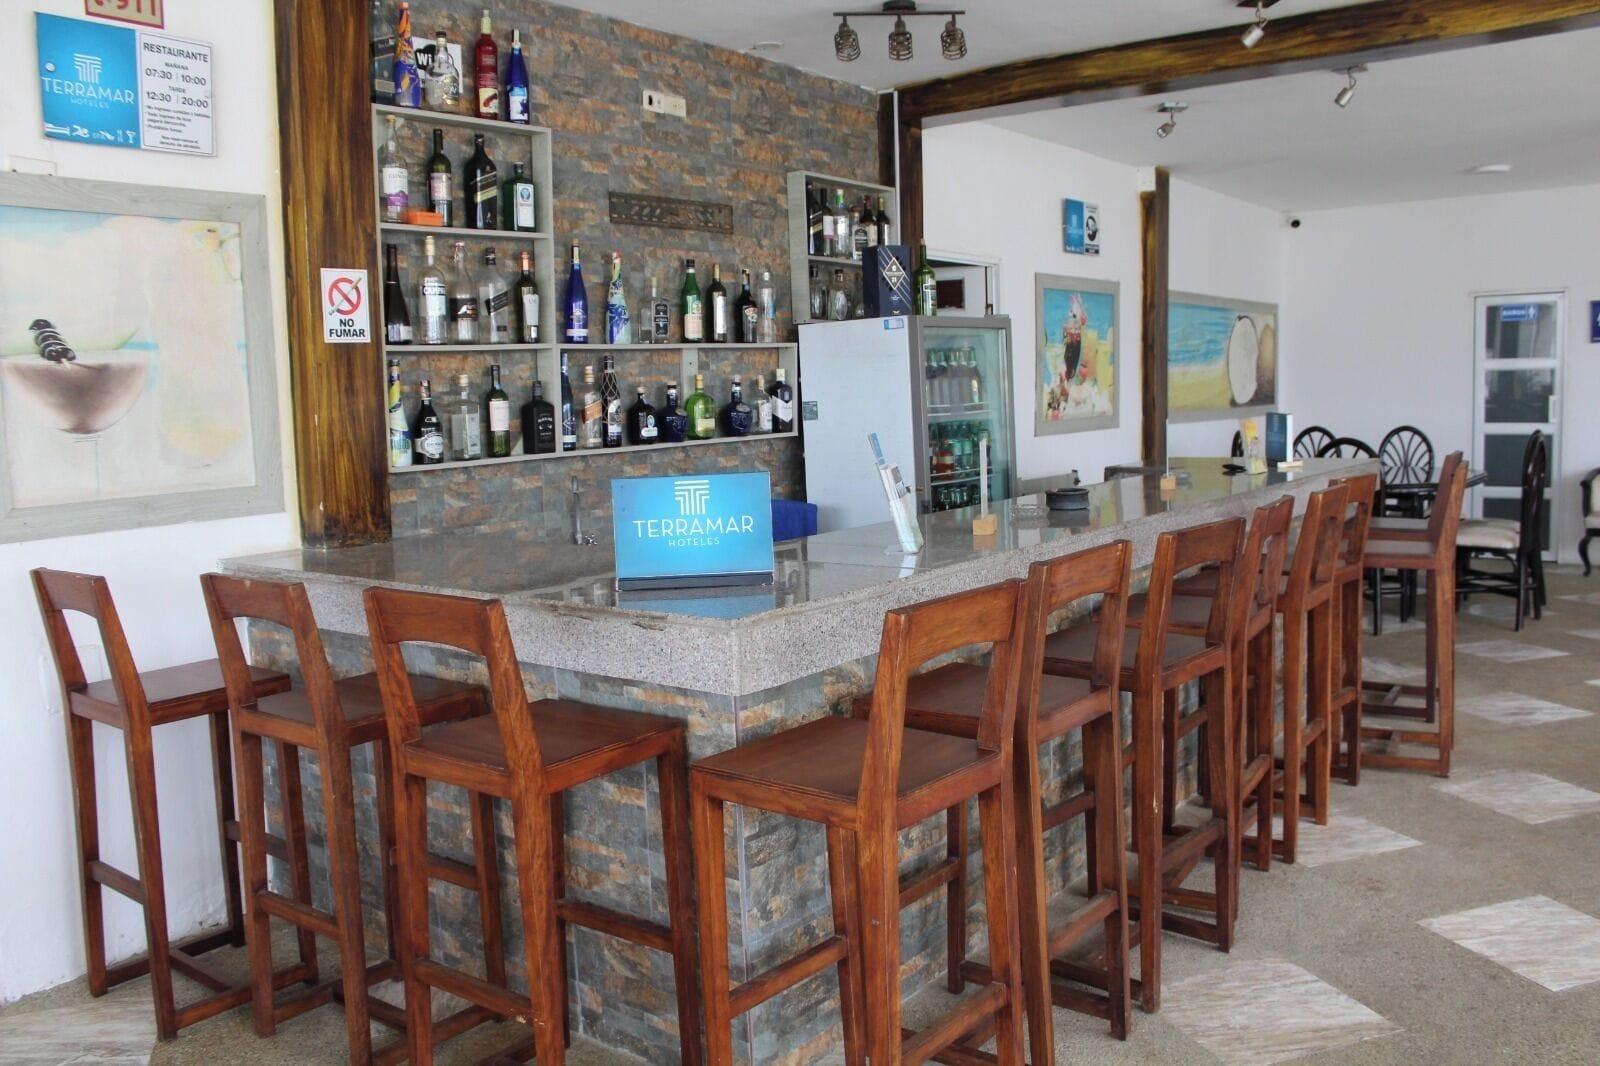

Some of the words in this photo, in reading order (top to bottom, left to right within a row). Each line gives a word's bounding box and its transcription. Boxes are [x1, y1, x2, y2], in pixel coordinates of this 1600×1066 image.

[143, 42, 209, 63] RESTAURANTE
[145, 68, 173, 80] 07:30
[181, 74, 207, 86] 10:00
[41, 77, 135, 105] TERRAMAR
[146, 91, 172, 103] 12:30
[181, 96, 209, 109] 20:00
[339, 318, 355, 328] NO
[329, 329, 366, 338] FUMAR
[632, 515, 754, 538] TERRAMAR
[668, 536, 721, 547] HOTELES
